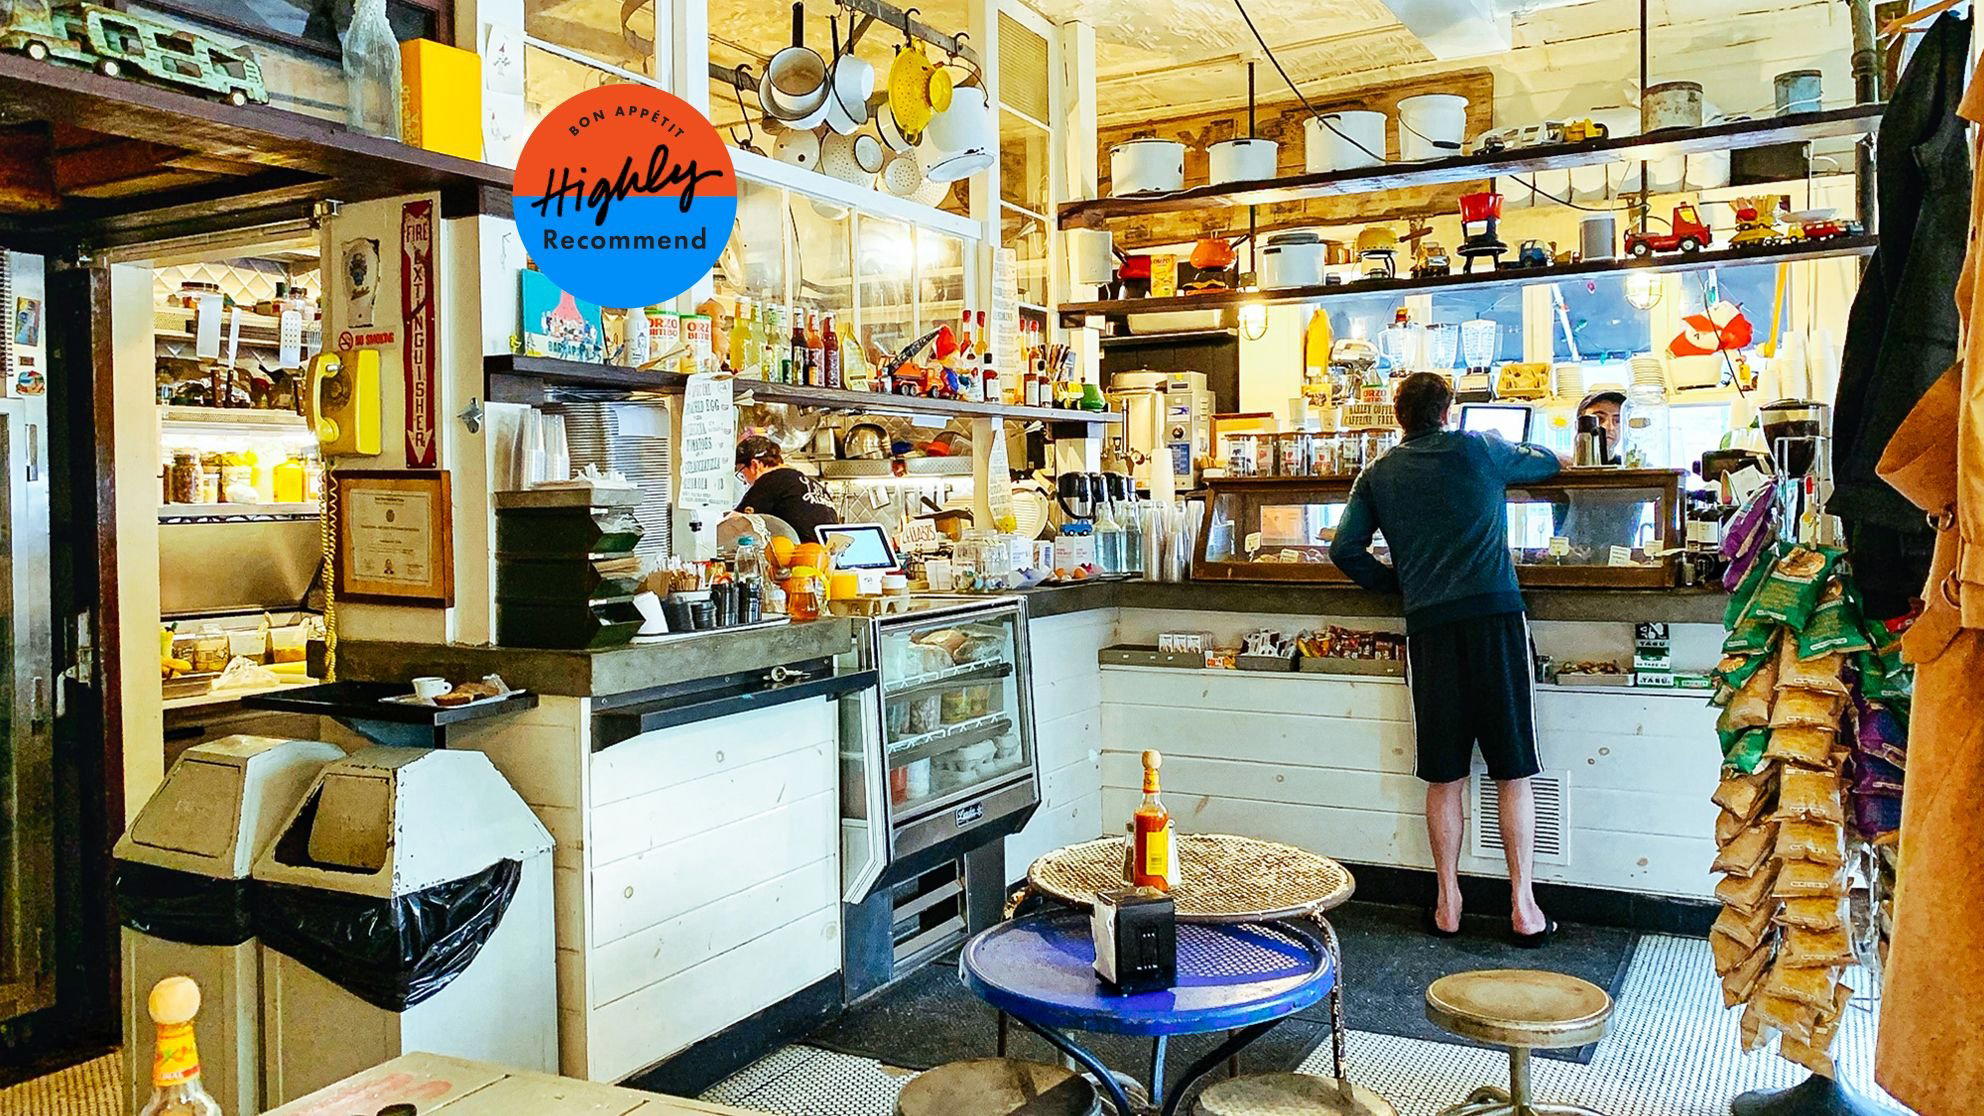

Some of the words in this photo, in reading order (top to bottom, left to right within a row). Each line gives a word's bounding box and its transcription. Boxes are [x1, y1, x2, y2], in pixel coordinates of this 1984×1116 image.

[406, 222, 428, 242] FIRE
[687, 321, 709, 333] ORZ
[355, 335, 364, 346] NO
[366, 332, 394, 345] SMOKING
[1373, 404, 1394, 415] COFFE
[1377, 415, 1394, 425] FREE
